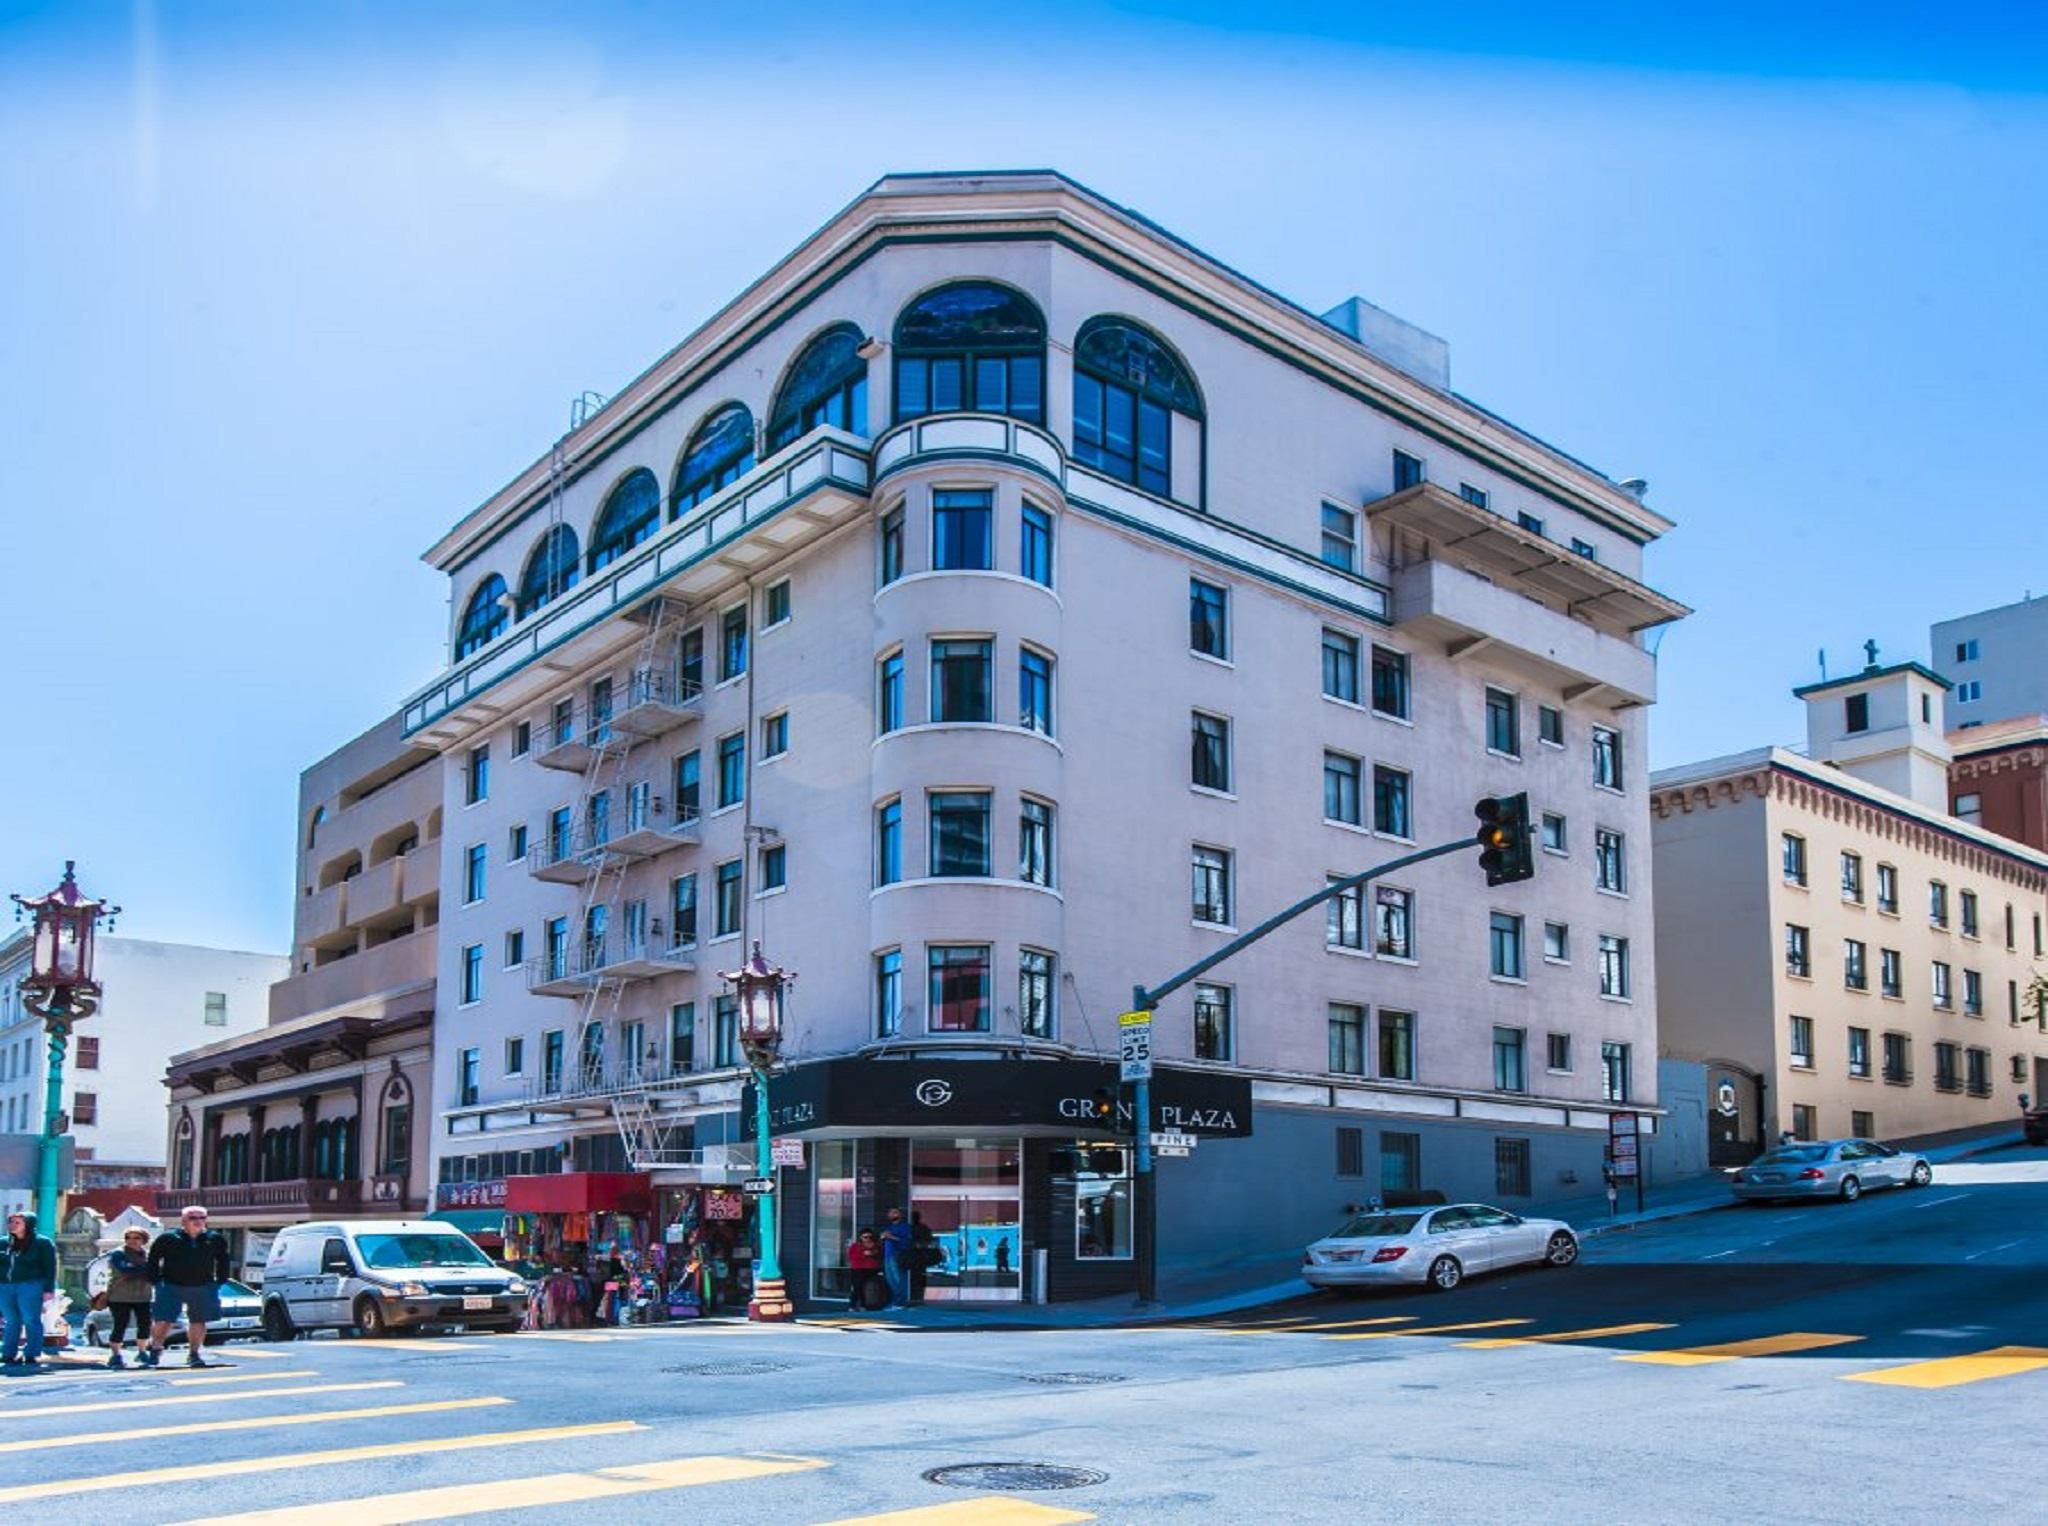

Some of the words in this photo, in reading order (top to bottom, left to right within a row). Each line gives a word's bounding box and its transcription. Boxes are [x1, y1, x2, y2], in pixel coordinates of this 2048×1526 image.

[1123, 1044, 1150, 1062] 25
[1059, 1098, 1136, 1121] GRN
[1161, 1106, 1237, 1129] PLAZA
[1157, 1134, 1192, 1146] PINE
